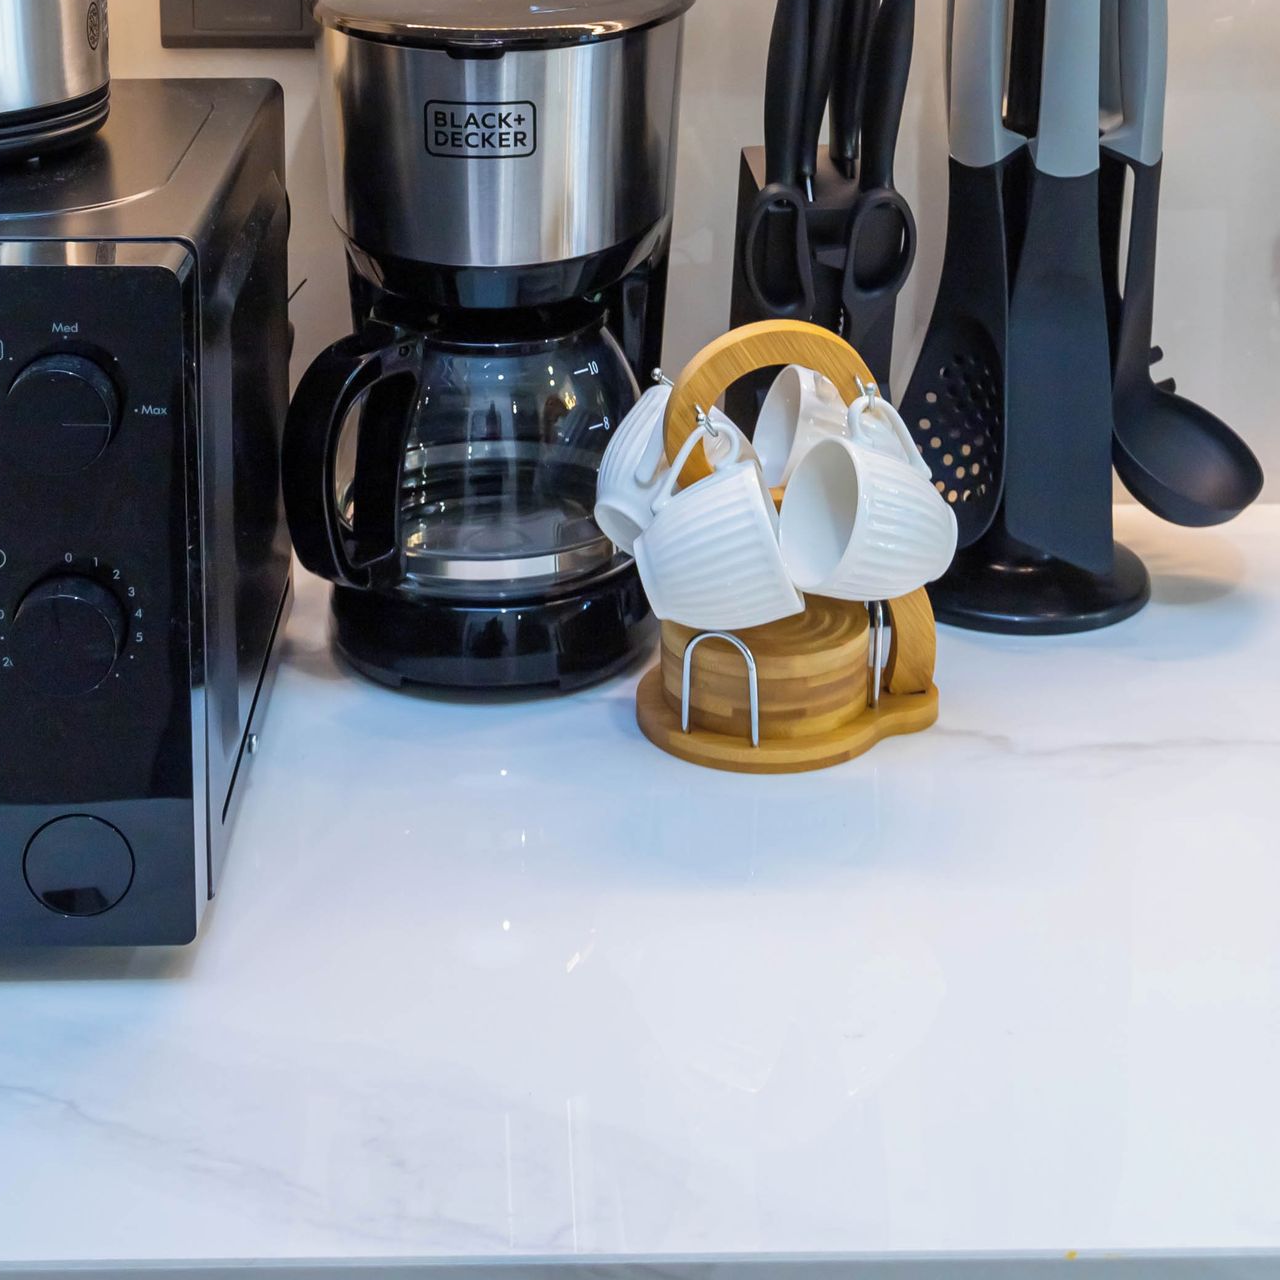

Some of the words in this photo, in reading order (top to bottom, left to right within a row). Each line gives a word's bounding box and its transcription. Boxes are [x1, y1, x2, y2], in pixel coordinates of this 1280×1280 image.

[434, 110, 526, 129] BLACK+
[434, 130, 527, 148] DECKER
[51, 322, 78, 333] Med
[587, 360, 599, 376] 10
[141, 405, 167, 415] Max
[603, 416, 610, 431] 8
[64, 552, 73, 563] 0
[112, 570, 120, 580] 2
[128, 586, 135, 597] 3
[135, 608, 142, 619] 4
[136, 631, 143, 642] 5
